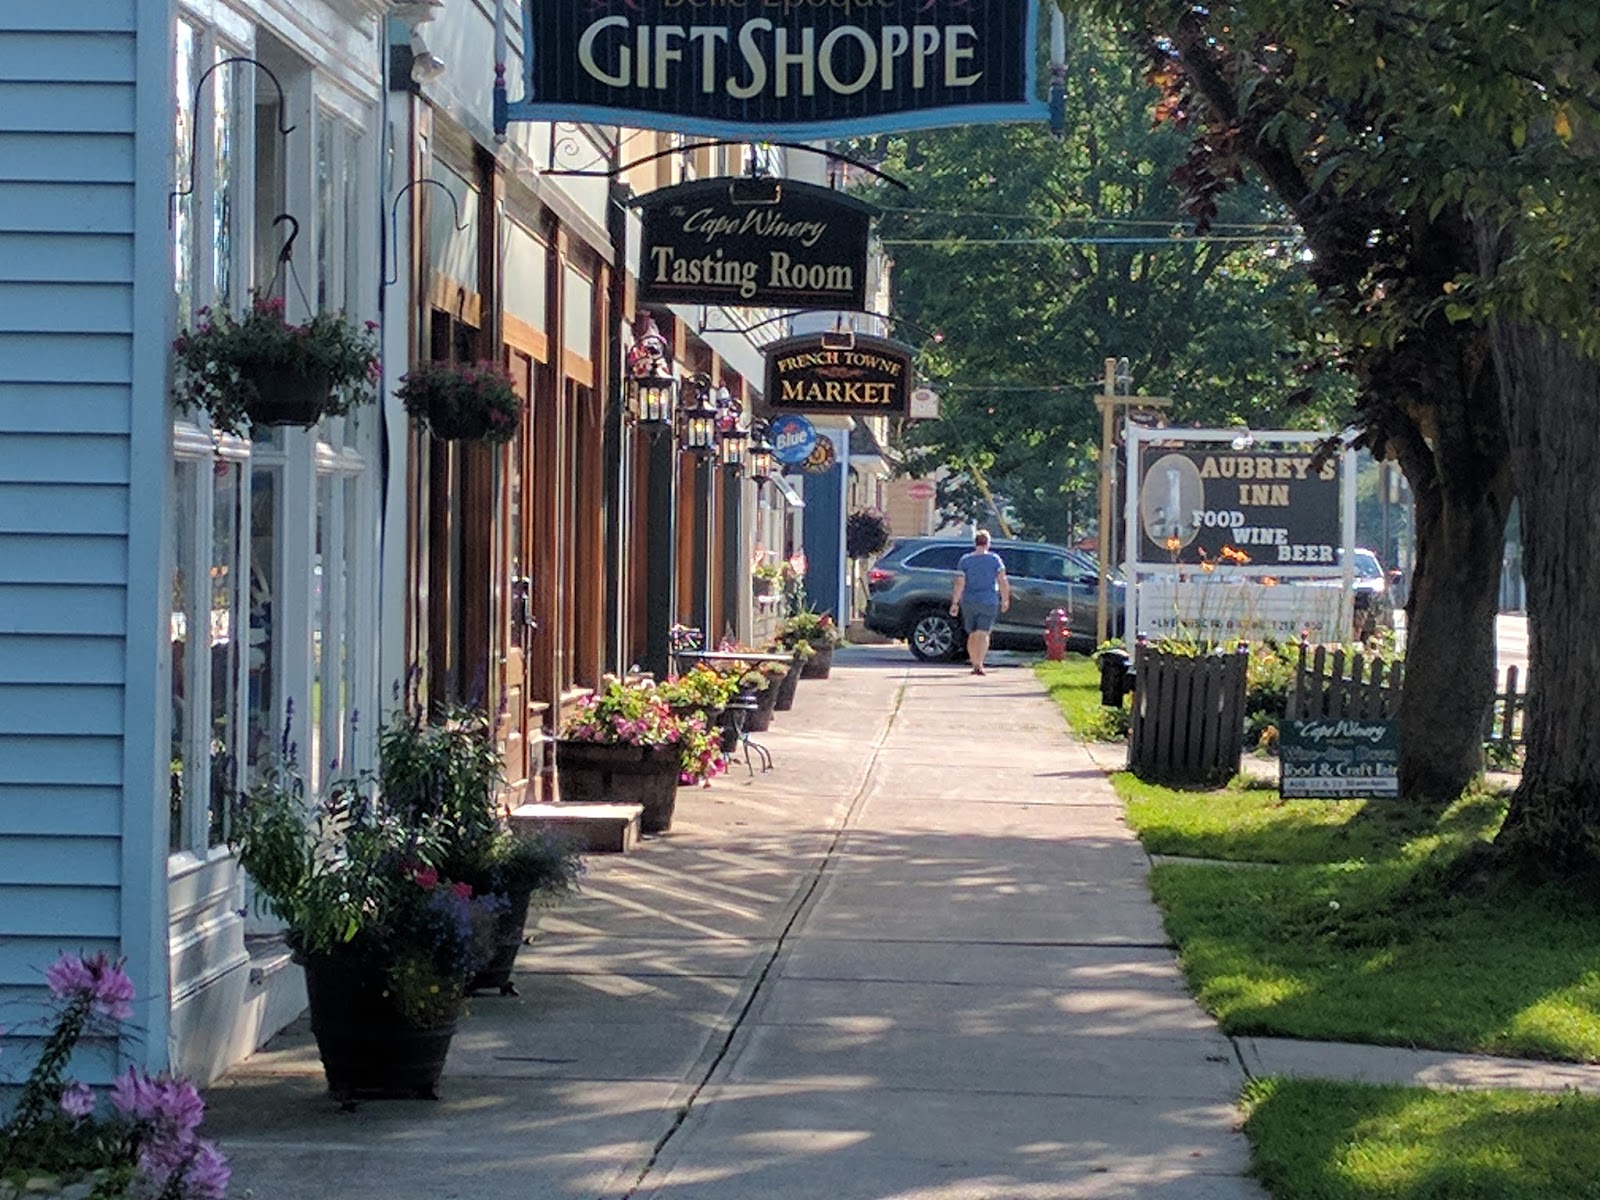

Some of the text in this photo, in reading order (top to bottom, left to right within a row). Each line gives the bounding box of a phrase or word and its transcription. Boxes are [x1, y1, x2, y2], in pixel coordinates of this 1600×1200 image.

[682, 207, 828, 248] Cape Winery
[650, 246, 854, 299] Tasting Room
[777, 352, 902, 377] FRENCH TOWNE
[781, 379, 896, 404] MARKET
[776, 430, 808, 451] Blue
[1200, 456, 1337, 480] AUBREYS
[1238, 483, 1290, 507] INN
[1191, 509, 1246, 528] FOOD
[1231, 527, 1289, 545] WINE
[1277, 543, 1334, 562] BEER
